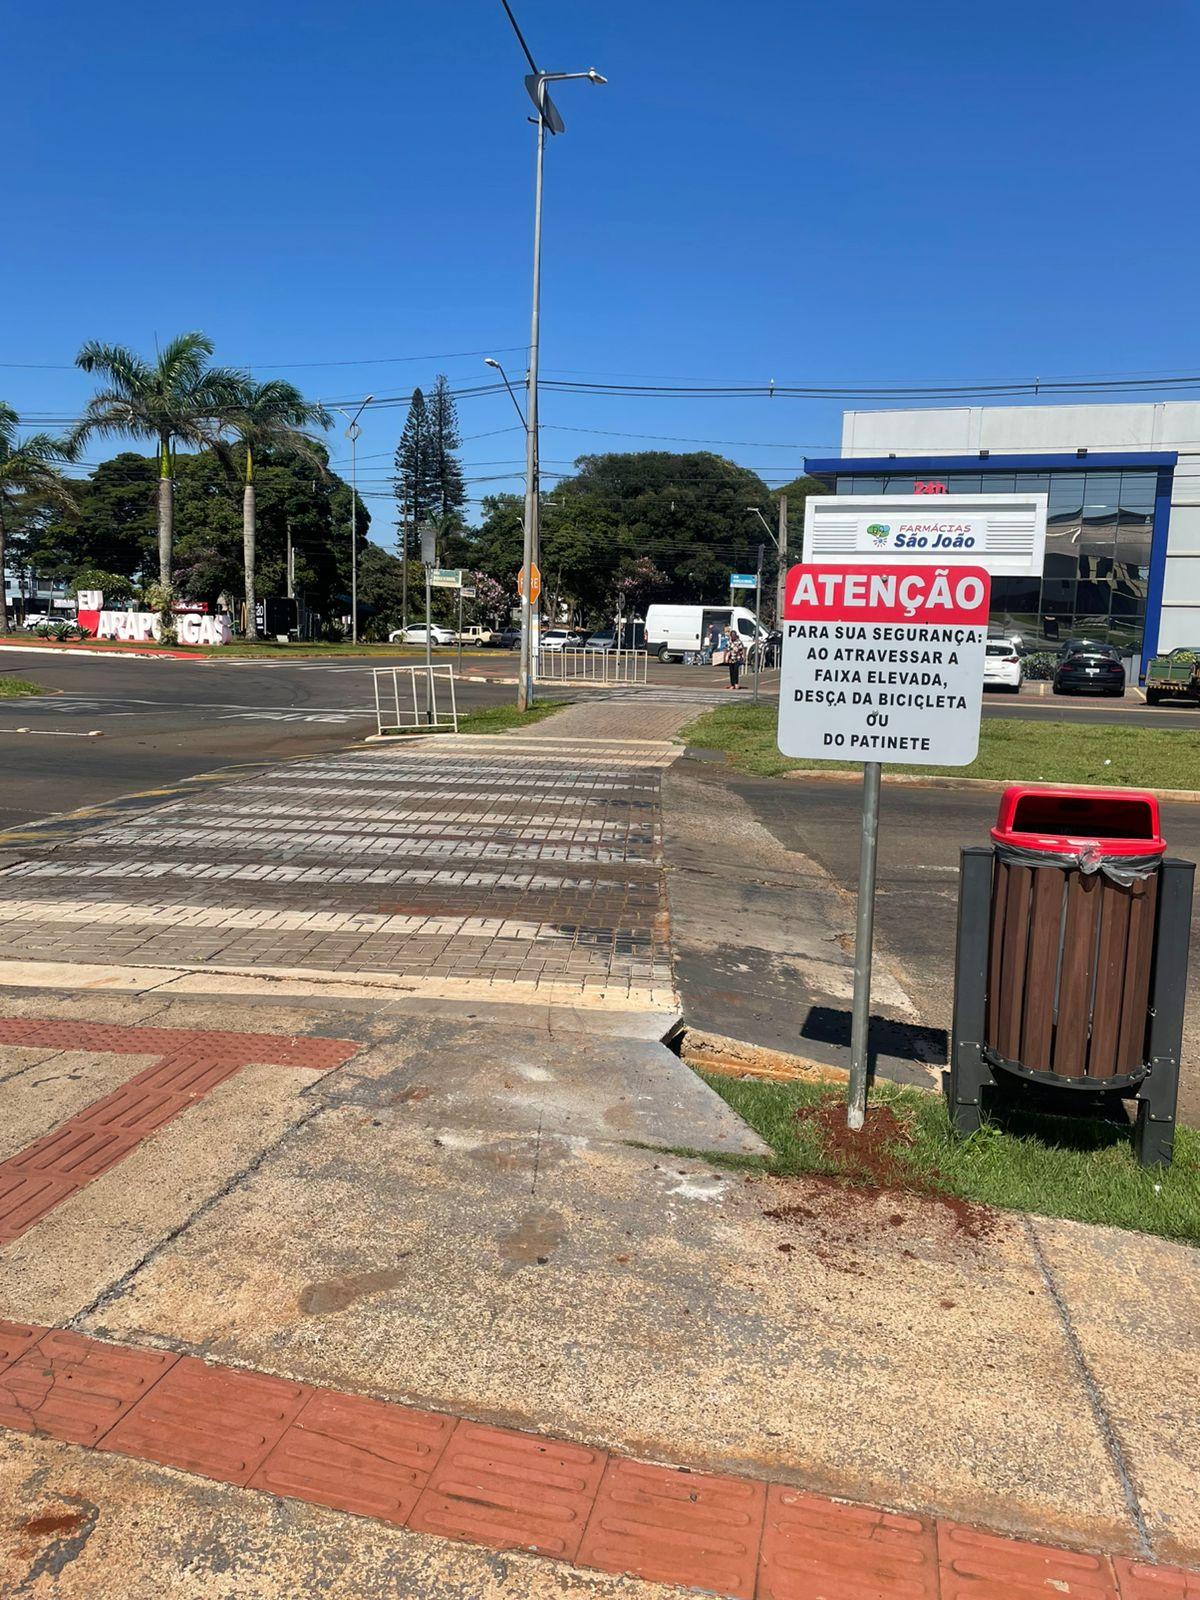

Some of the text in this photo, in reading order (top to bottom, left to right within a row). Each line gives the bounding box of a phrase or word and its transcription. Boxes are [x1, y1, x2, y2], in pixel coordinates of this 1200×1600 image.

[899, 523, 972, 533] FARMÁCIAS
[894, 533, 975, 548] São João
[78, 590, 103, 611] EU
[791, 568, 985, 617] ATENÇÃO
[788, 625, 983, 646] PARA SUA SEGURANÇA:
[807, 647, 959, 665] AO ATRAVESSAR A
[814, 669, 948, 689] FAIXA ELEVADA,
[794, 690, 846, 707] DESÇA
[852, 692, 873, 705] DA
[866, 714, 889, 727] OU
[823, 733, 931, 751] DO PATINETE
